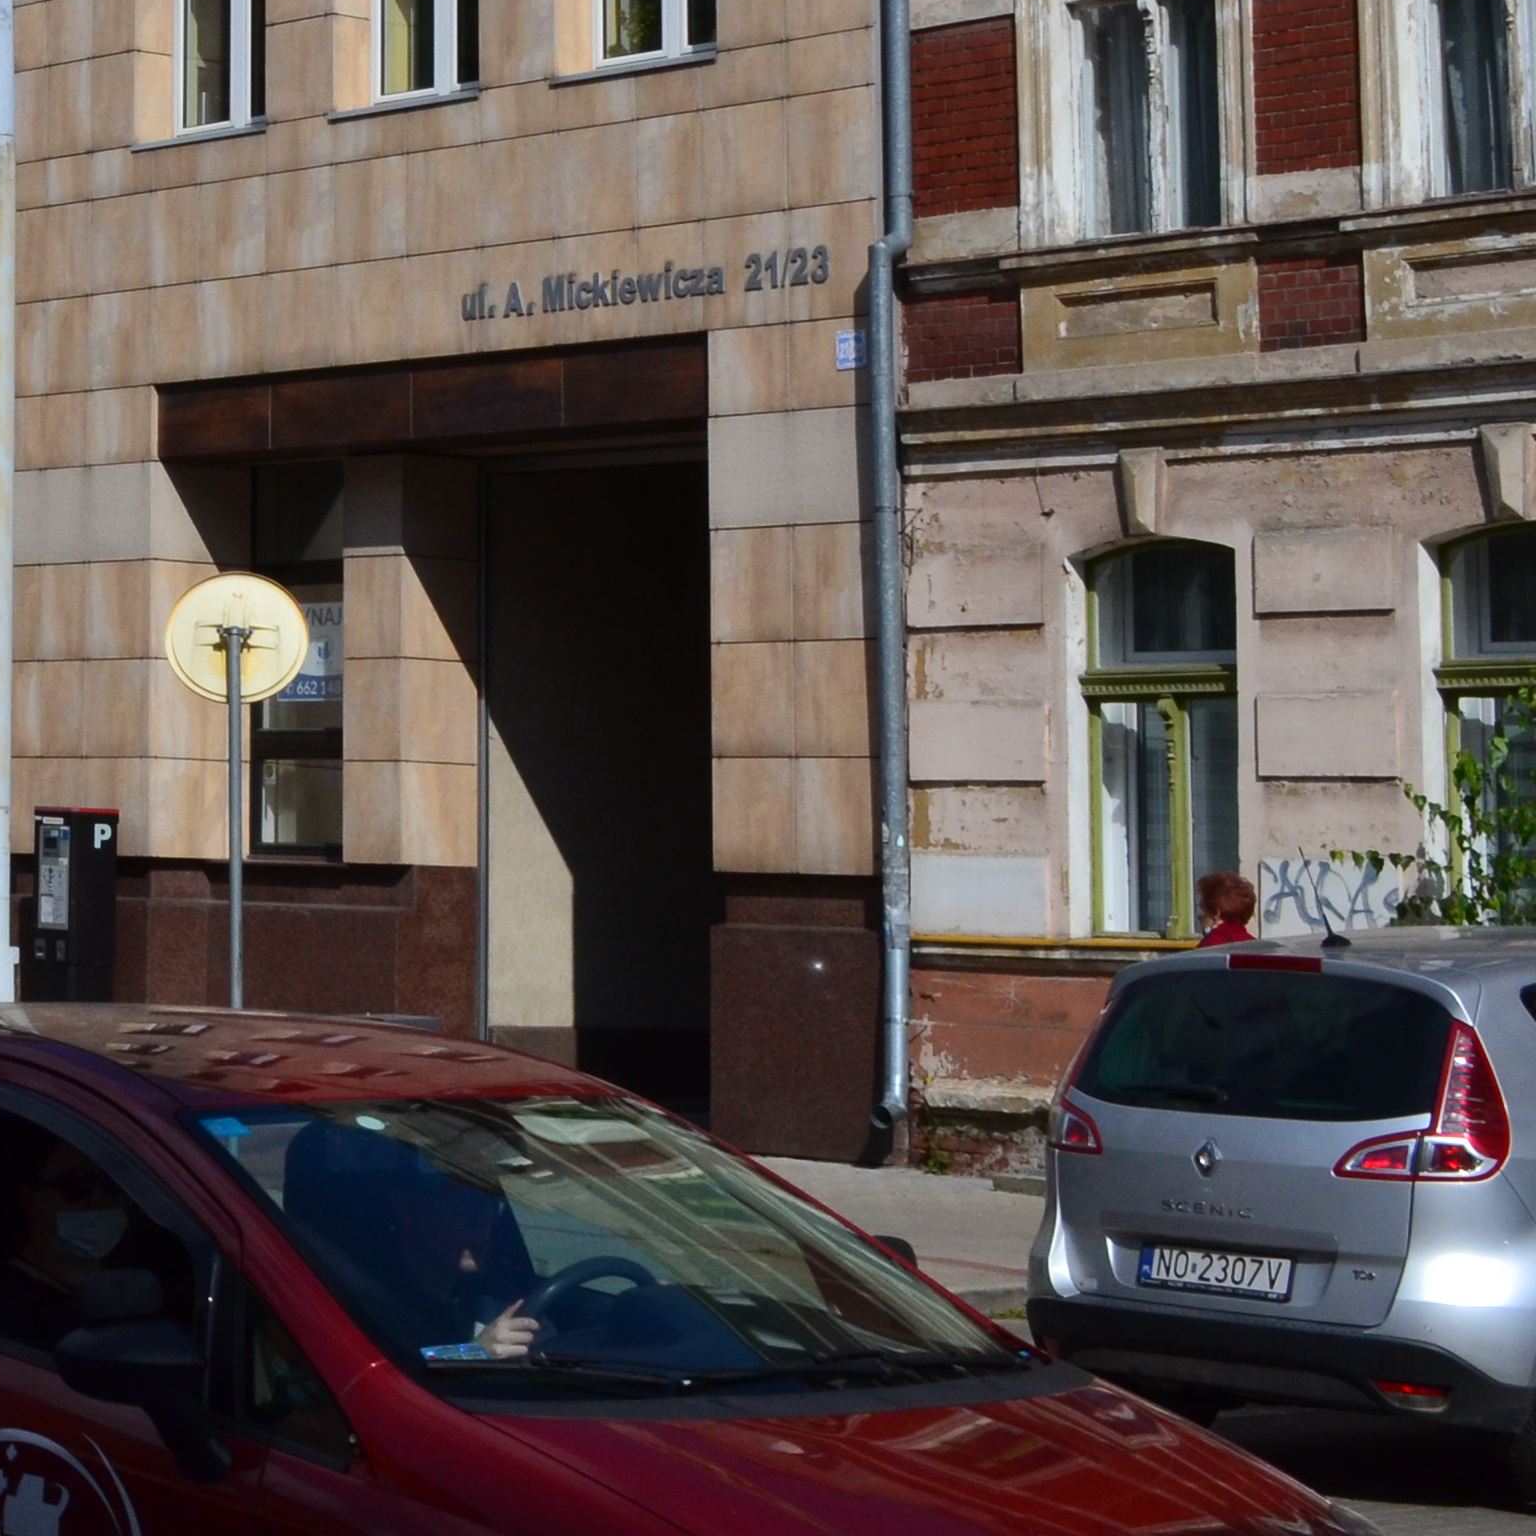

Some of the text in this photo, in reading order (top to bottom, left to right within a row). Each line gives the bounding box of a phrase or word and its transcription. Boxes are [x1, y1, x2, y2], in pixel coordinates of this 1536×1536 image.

[461, 244, 831, 322] ul. A. Mickiewicza 21/23
[296, 680, 318, 695] 662
[93, 822, 112, 849] P
[1161, 1198, 1254, 1220] SCENIC
[1156, 1247, 1190, 1280] NO
[1198, 1252, 1283, 1290] 2307V
